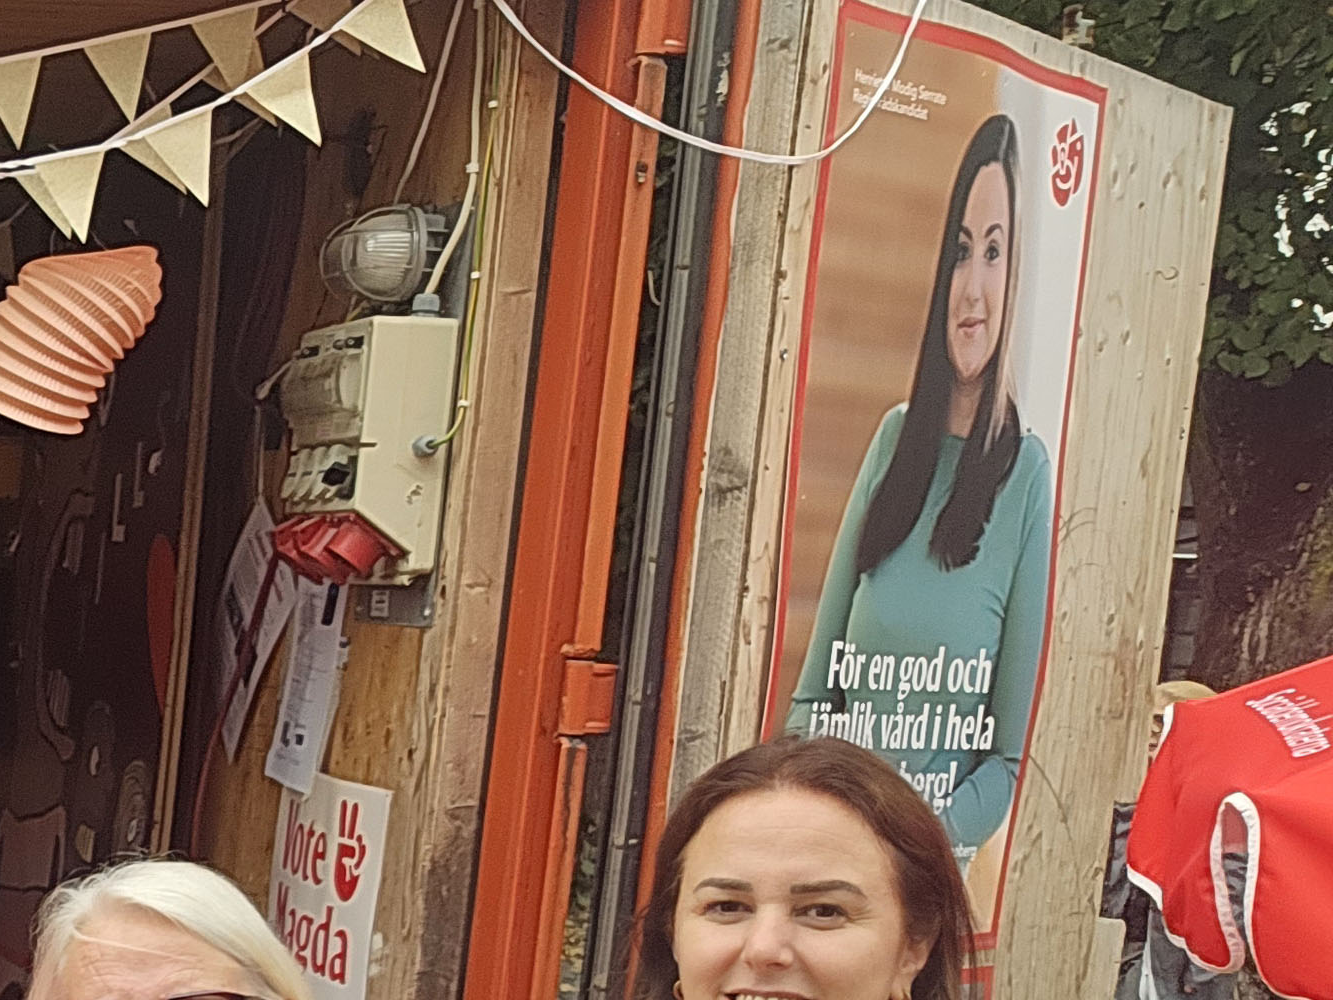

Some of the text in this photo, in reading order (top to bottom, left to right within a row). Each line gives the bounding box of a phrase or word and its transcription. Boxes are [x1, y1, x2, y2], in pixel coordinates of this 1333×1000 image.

[827, 640, 993, 700] För en god och
[881, 701, 930, 750] vård
[931, 705, 942, 750] i
[944, 704, 995, 750] hela
[283, 799, 327, 886] Vote
[275, 881, 349, 985] Magda
